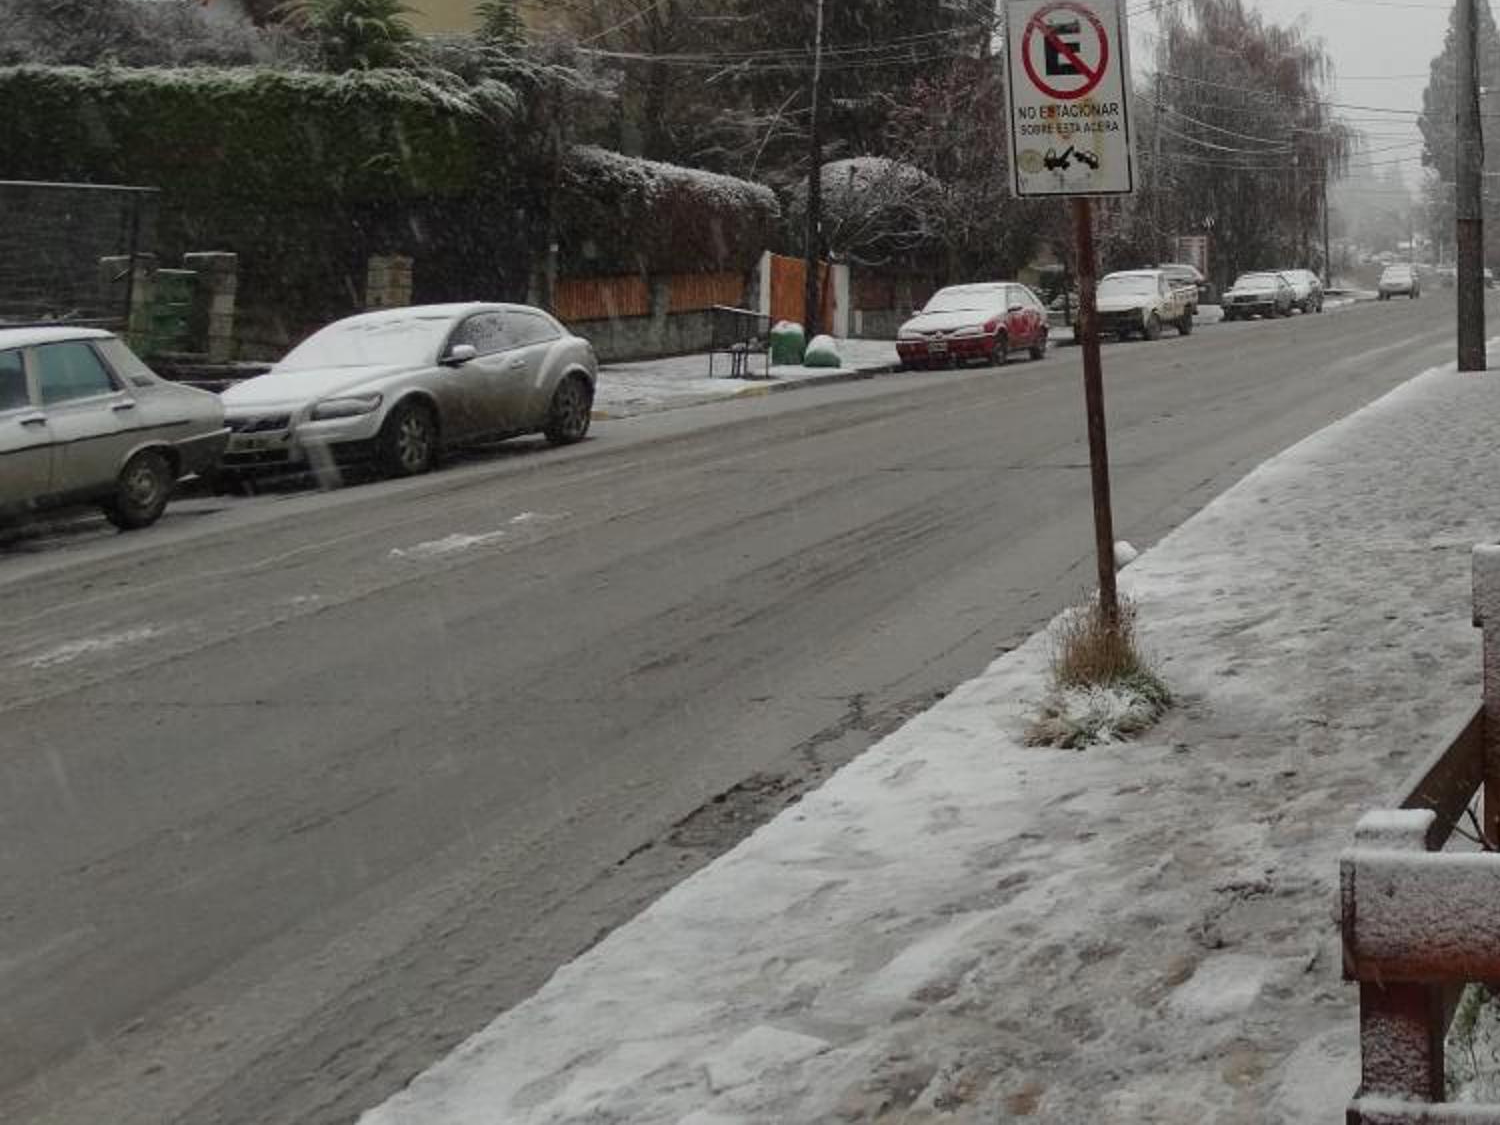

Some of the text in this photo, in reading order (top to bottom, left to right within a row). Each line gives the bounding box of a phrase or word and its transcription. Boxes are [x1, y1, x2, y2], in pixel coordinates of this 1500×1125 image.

[1045, 20, 1082, 75] E
[1019, 103, 1119, 119] NO ESTACIONAR
